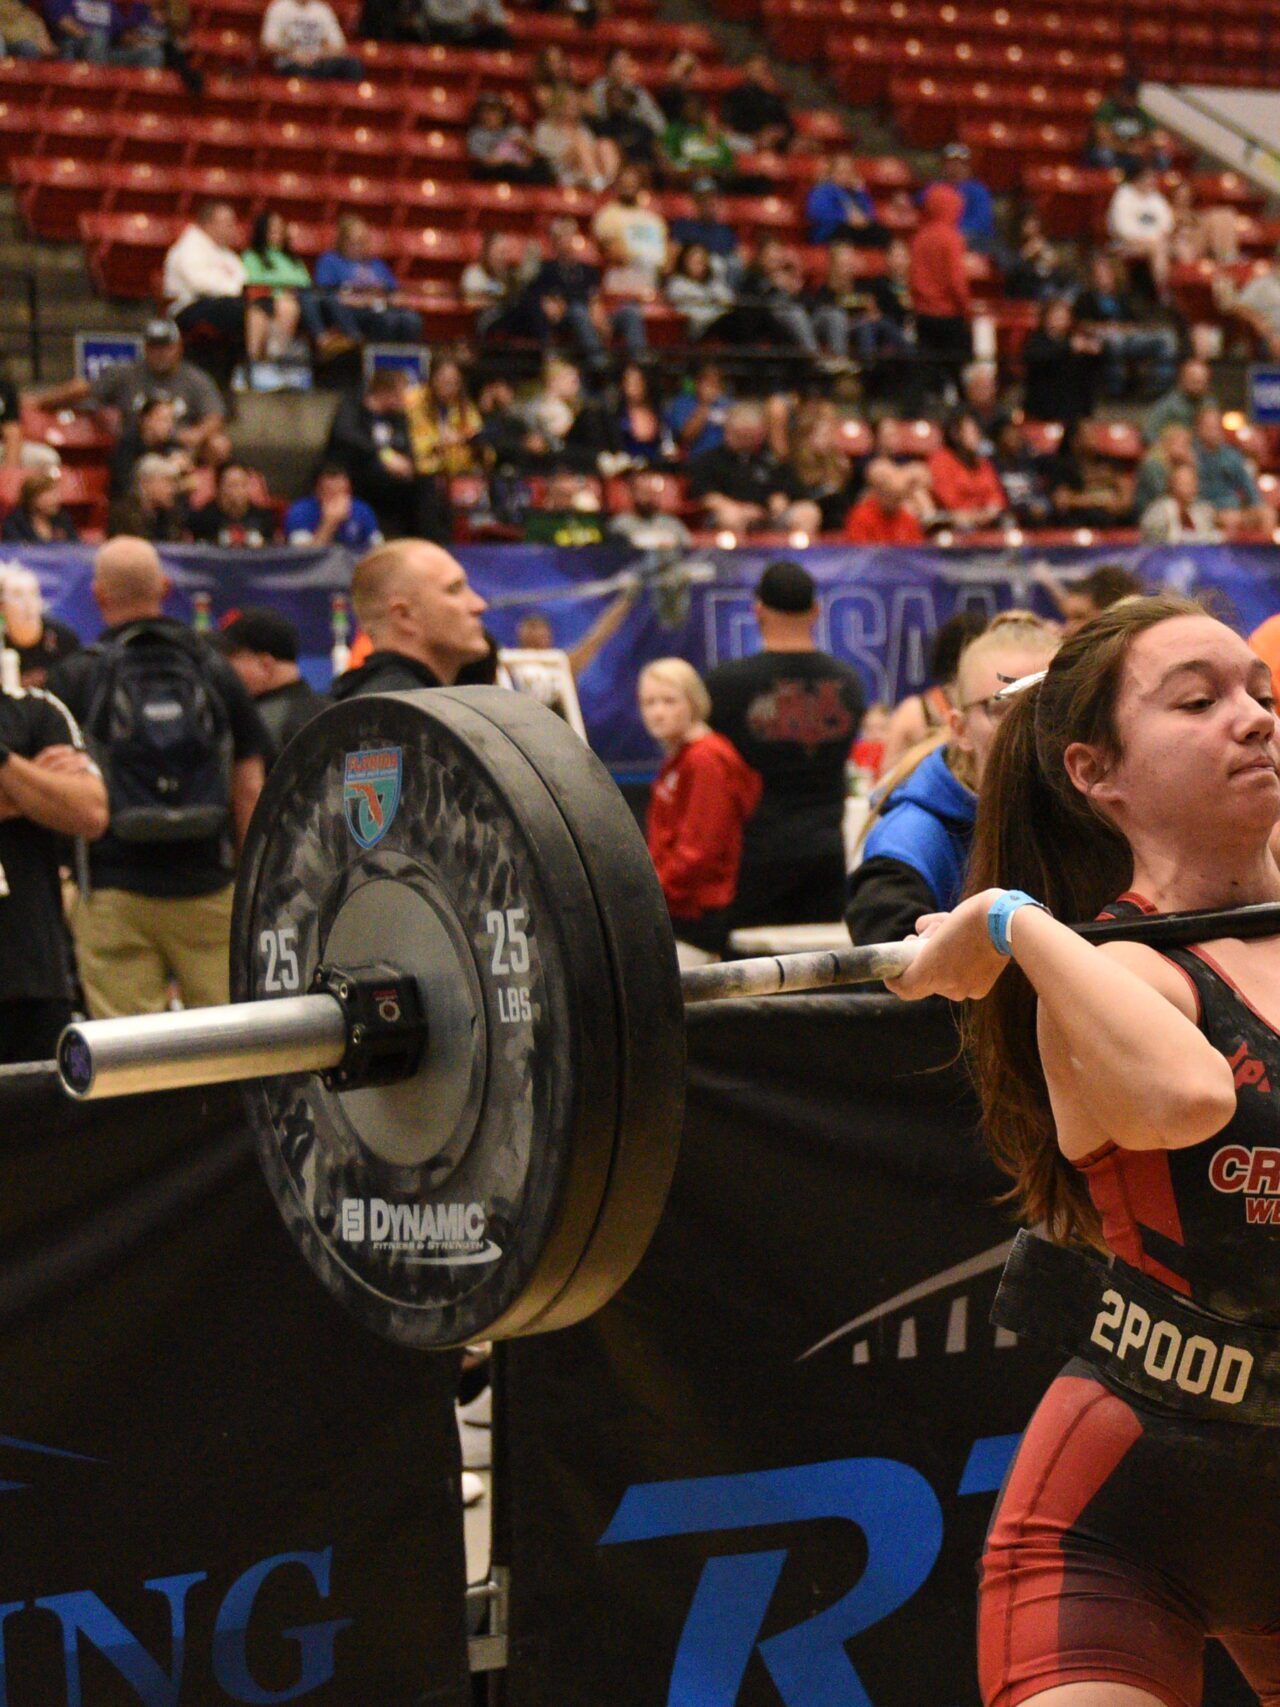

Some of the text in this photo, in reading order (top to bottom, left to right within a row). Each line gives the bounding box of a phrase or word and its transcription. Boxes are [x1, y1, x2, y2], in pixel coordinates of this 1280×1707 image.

[260, 928, 299, 991] 25
[487, 909, 530, 976] 25
[498, 987, 532, 1023] LBS
[370, 1198, 486, 1242] DYNAMIC
[1090, 1288, 1255, 1405] 2POOD
